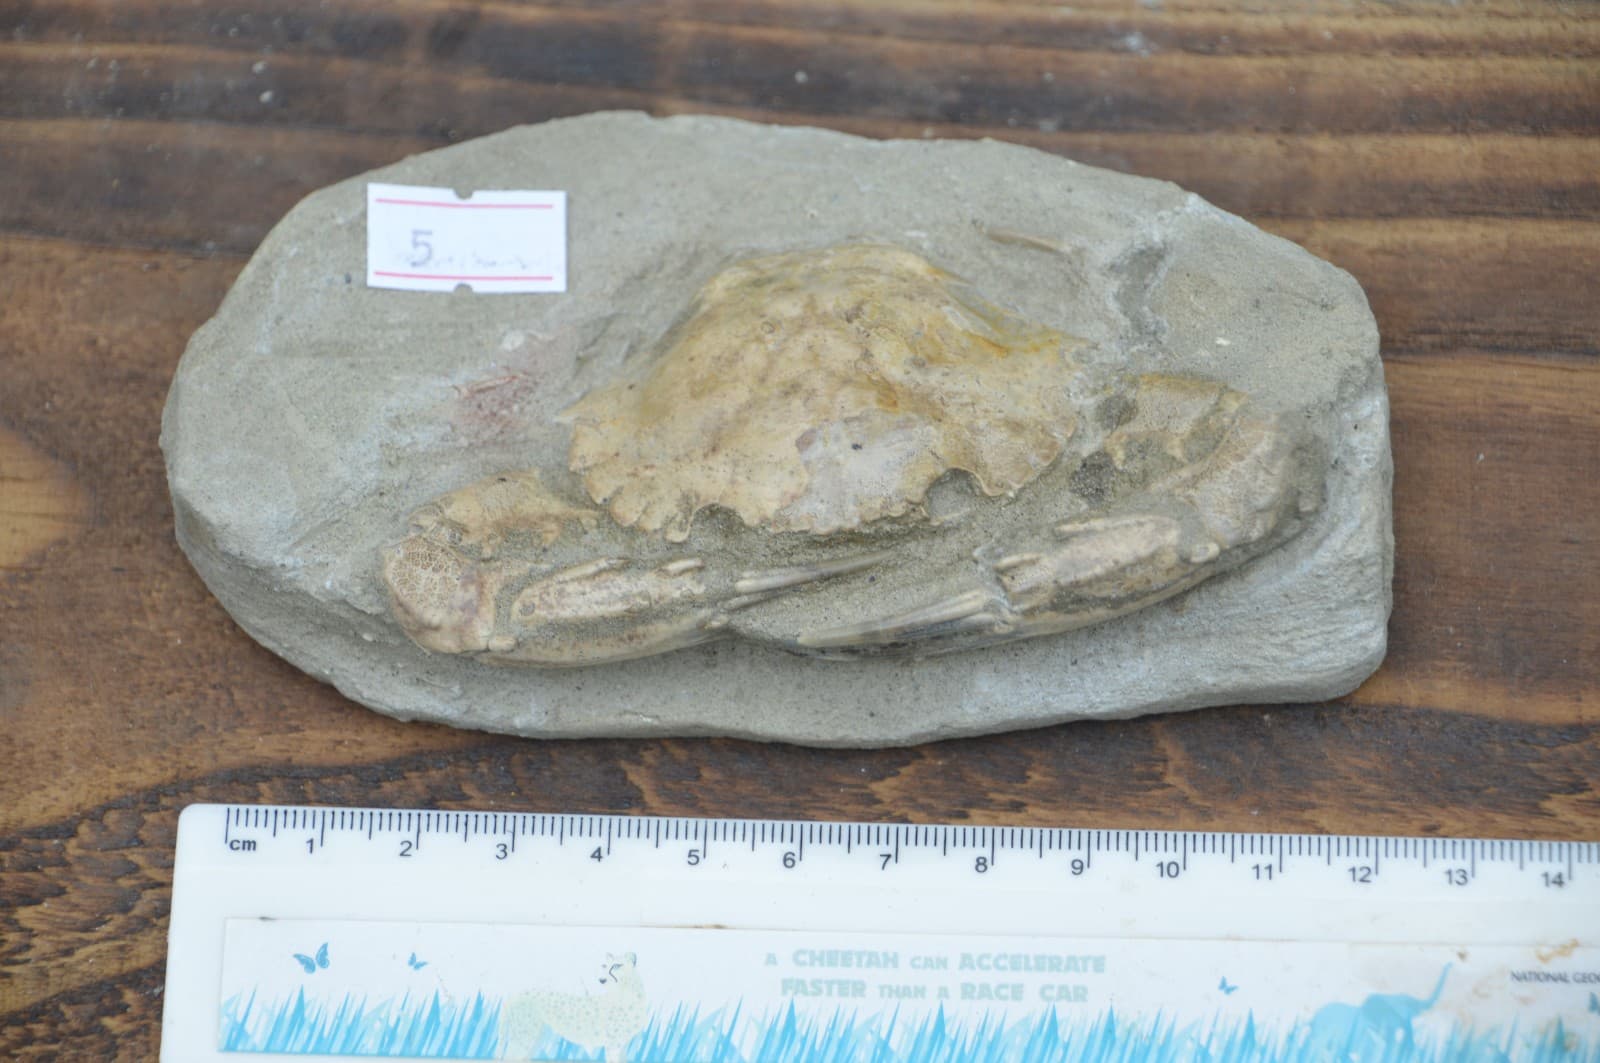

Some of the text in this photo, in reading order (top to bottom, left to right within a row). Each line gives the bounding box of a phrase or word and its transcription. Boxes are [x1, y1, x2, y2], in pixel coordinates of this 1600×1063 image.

[410, 229, 433, 268] 5
[229, 837, 1565, 888] cm 1 2 3 4 5 6 7 8 9 10 11 12 13 14
[765, 948, 1106, 974] A CHEETAH CAN ACCELERATE
[1511, 970, 1570, 983] NATIONAL
[781, 978, 1089, 1003] FASTER THAN A RACE CAR
